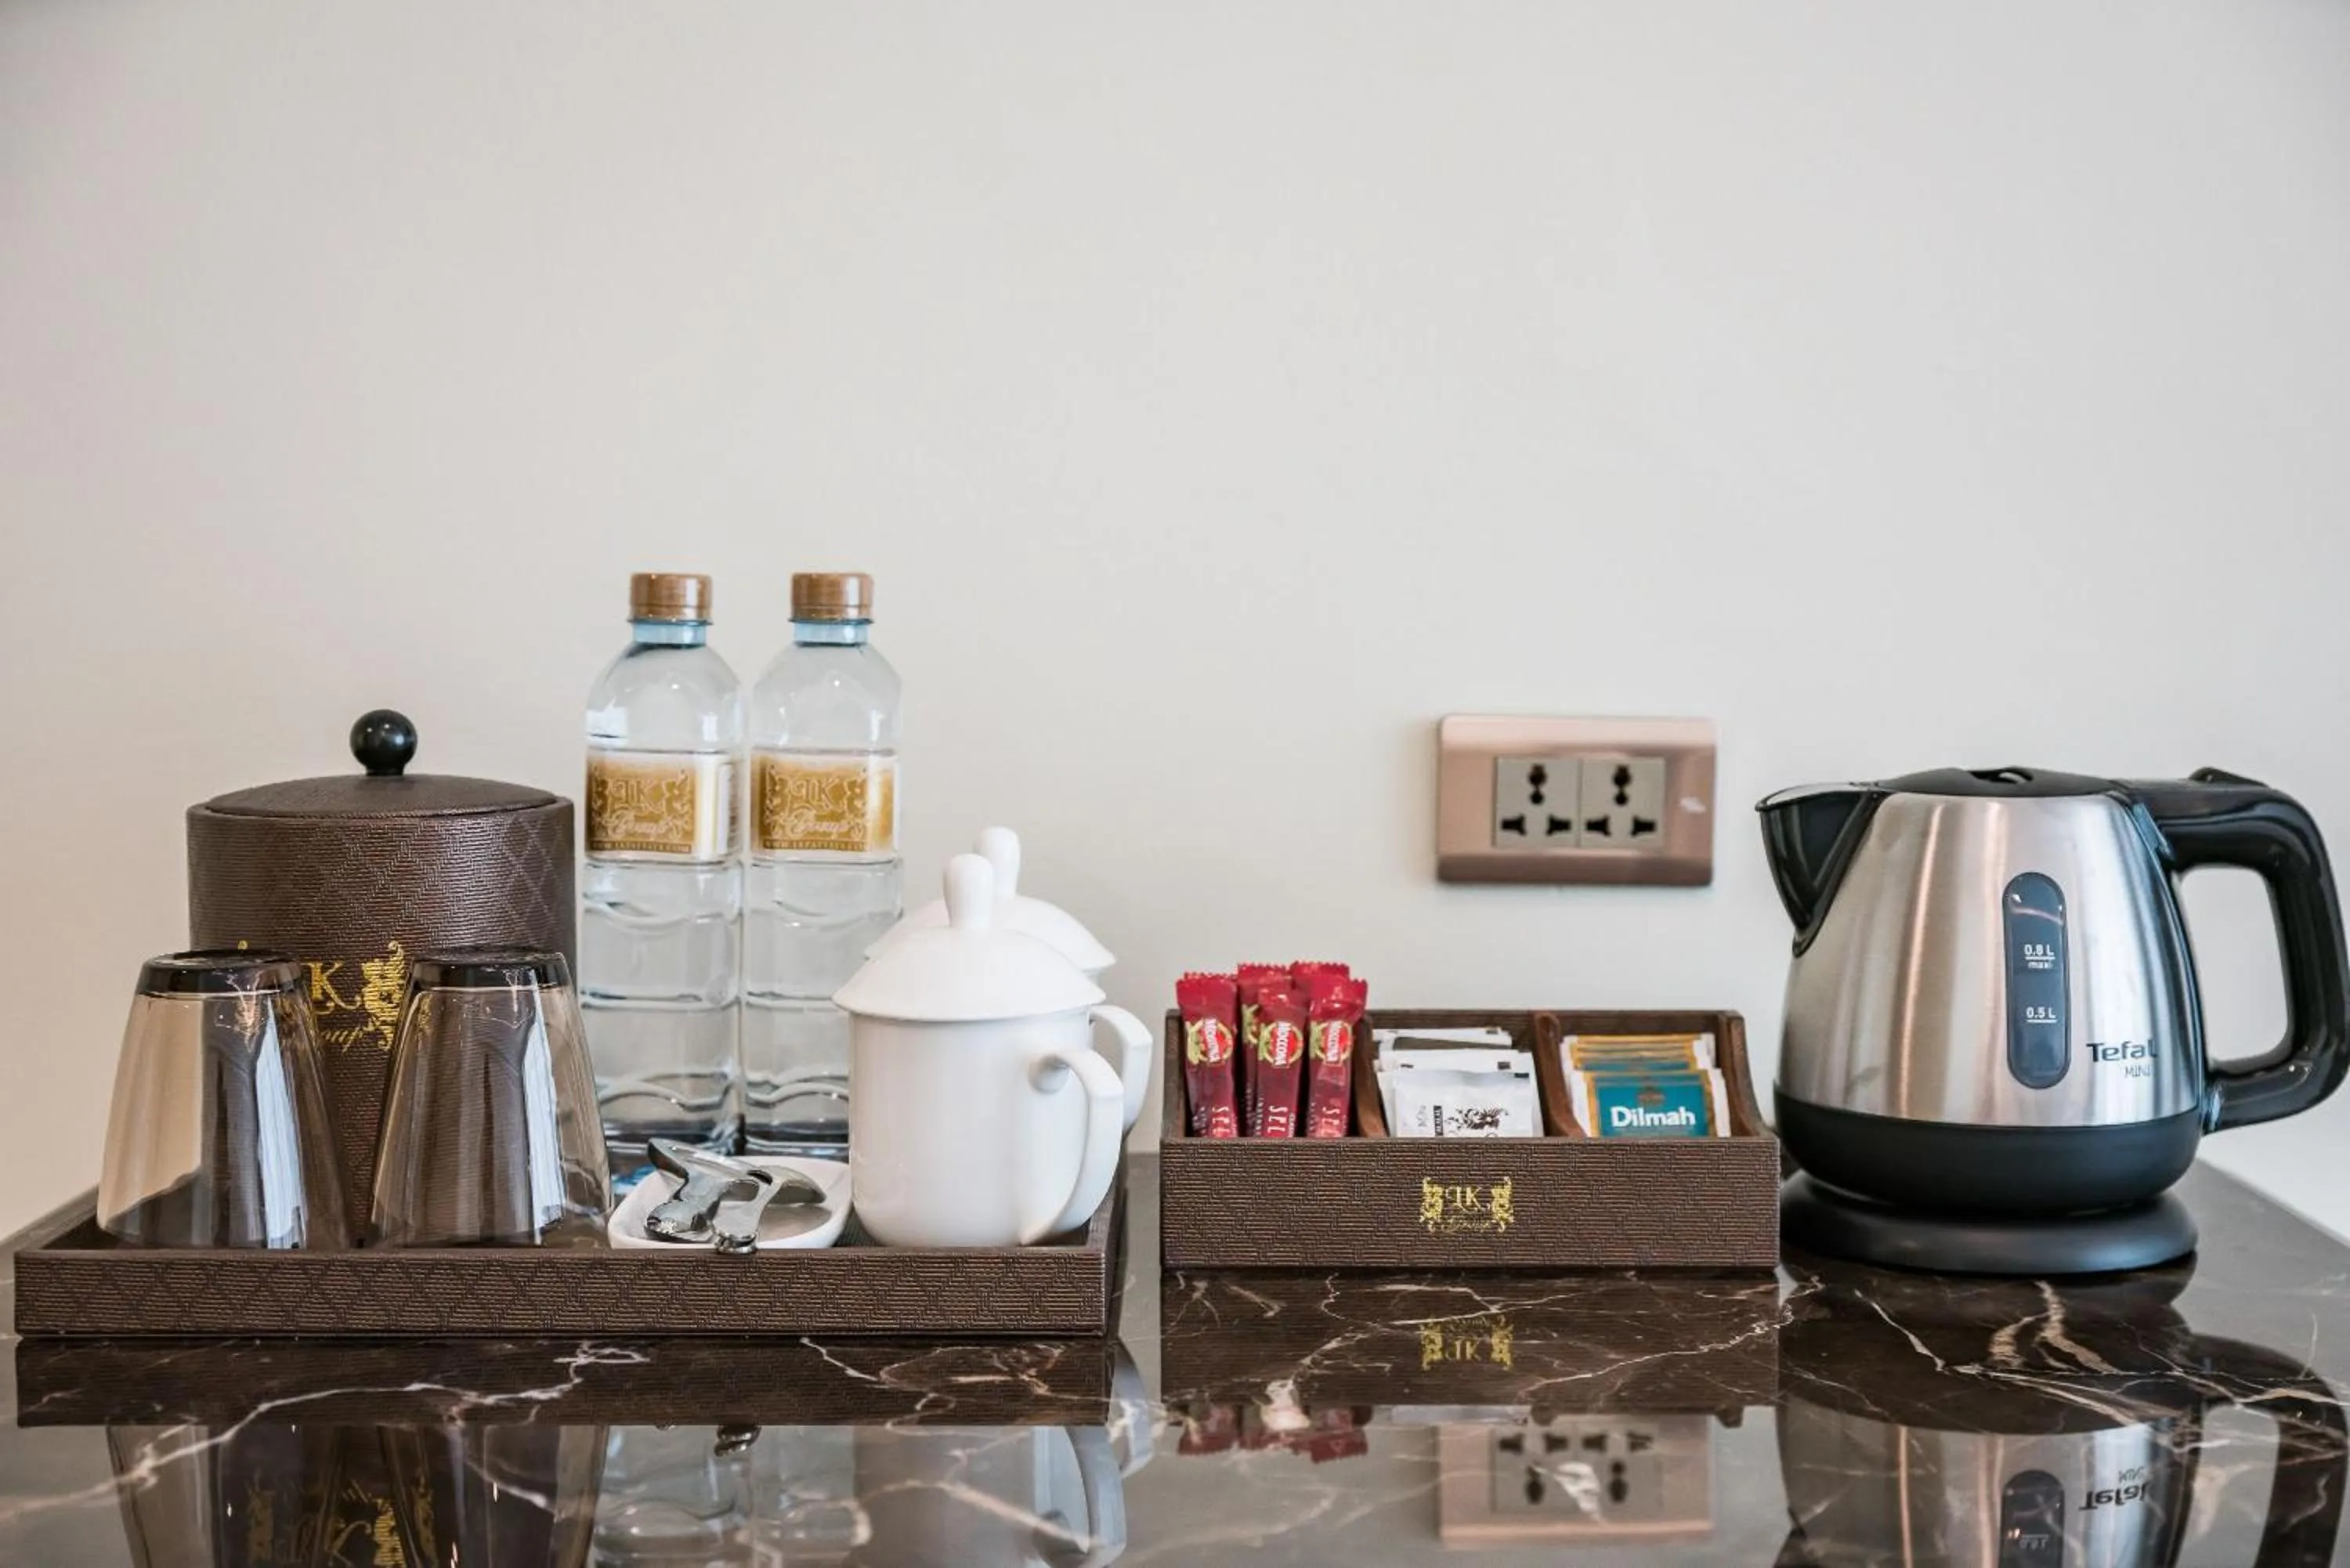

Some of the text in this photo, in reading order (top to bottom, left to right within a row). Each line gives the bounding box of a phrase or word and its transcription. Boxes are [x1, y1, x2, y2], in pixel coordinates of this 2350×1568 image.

[2024, 943, 2055, 956] 0.8 L
[2026, 1006, 2056, 1019] 0.5 L
[2086, 1039, 2158, 1063] Tefal
[1611, 1105, 1696, 1127] Dilmah
